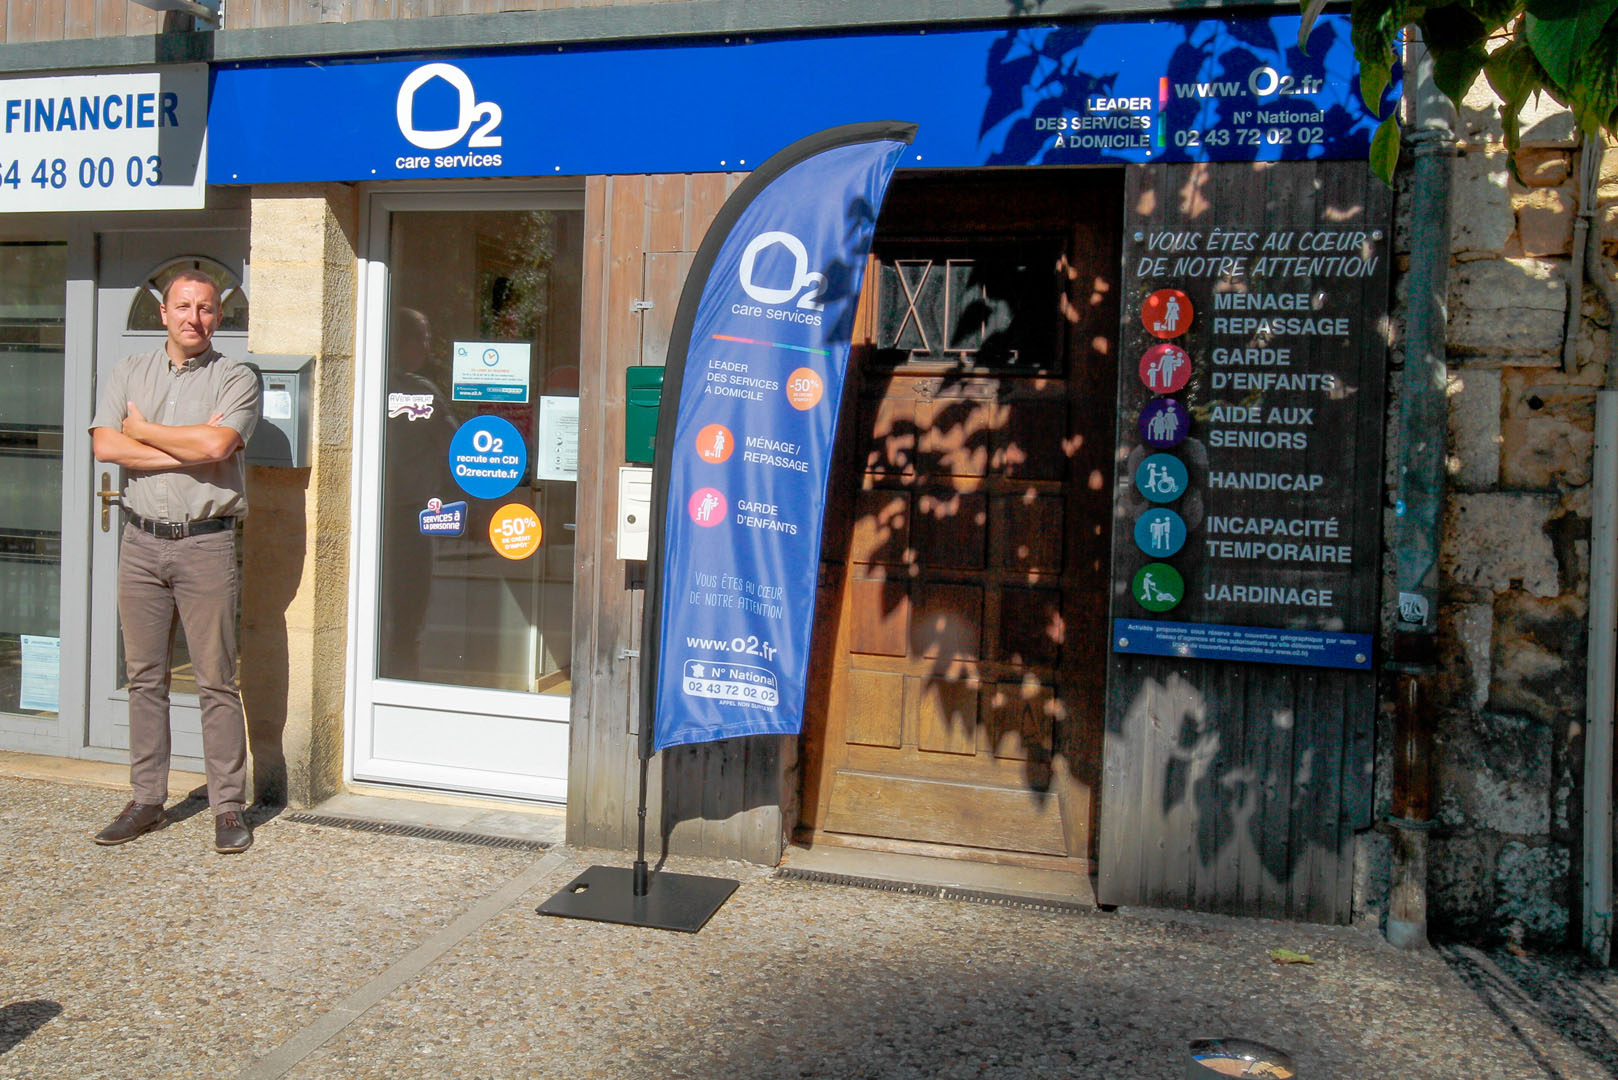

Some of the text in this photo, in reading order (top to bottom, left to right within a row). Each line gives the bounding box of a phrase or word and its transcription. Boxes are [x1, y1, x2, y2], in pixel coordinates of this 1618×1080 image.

[5, 92, 179, 133] FINANCIER
[397, 63, 502, 149] O2
[1087, 97, 1151, 111] LEADER
[1035, 115, 1151, 130] DES SERVICES
[1233, 109, 1324, 124] N° National
[1054, 132, 1150, 148] À DOMICILE
[1175, 127, 1324, 147] 02 43 72 02 02
[395, 151, 502, 169] care services
[0, 155, 162, 190] 4 48 00 03
[1149, 231, 1202, 251] VOUS
[1206, 227, 1259, 251] ÊTES
[1262, 232, 1294, 251] AU
[739, 231, 829, 312] O2
[1137, 256, 1379, 278] DE NOTRE ATTENTION
[731, 303, 822, 326] care services
[1213, 317, 1349, 336] REPASSAGE
[708, 359, 748, 373] LEADER
[1212, 348, 1290, 366] GARDE
[706, 372, 779, 391] DES SERVICES
[1211, 372, 1335, 391] D'ENFANTS
[704, 383, 764, 401] À DOMICILE
[1210, 406, 1314, 425] AIDE AUX
[473, 430, 504, 453] O2
[1209, 430, 1308, 450] SENIORS
[456, 455, 519, 465] recrute en CDI
[743, 451, 809, 473] REPASSAGE
[456, 464, 519, 479] O2recrute.fr
[1208, 471, 1324, 492] HANDICAP
[423, 510, 461, 524] services à
[737, 499, 778, 516] GARDE
[430, 522, 461, 531] personne
[494, 516, 537, 536] -50%
[736, 514, 798, 535] D'ENFANTS
[1207, 516, 1339, 538] INCAPACITÉ
[1206, 540, 1352, 563] TEMPORAIRE
[695, 571, 718, 588] VOUS
[721, 573, 743, 591] ÊTES
[745, 580, 755, 595] AU
[689, 591, 783, 619] DE NOTRE ATTENTION
[1204, 584, 1333, 607] JARDINAGE
[711, 667, 775, 687] N° National
[688, 681, 775, 702] 02 43 72 02 02
[719, 699, 737, 707] APPEL
